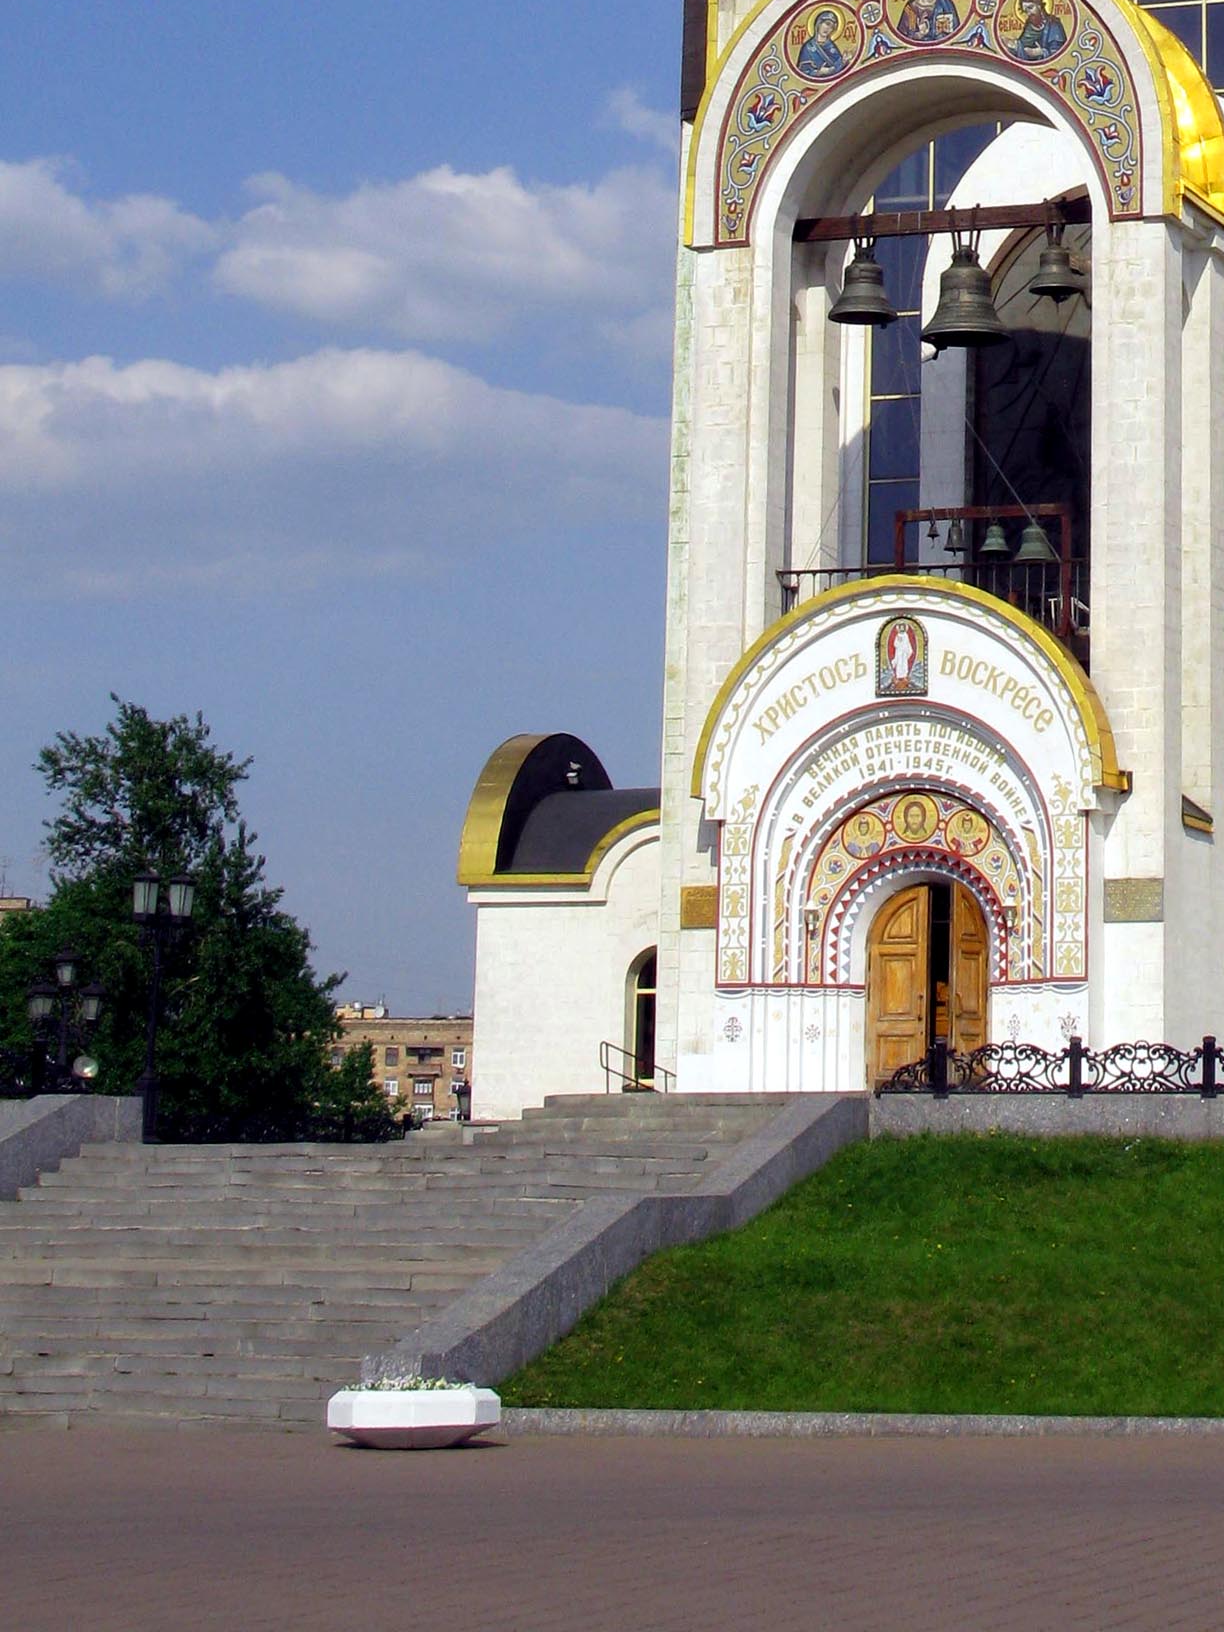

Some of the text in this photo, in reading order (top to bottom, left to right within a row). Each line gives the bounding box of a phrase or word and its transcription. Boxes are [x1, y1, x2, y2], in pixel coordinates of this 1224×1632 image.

[751, 652, 868, 747] ХРИСТОСЪ
[792, 739, 1028, 825] В ВЕЛИКОЙ ОТЕЧЕСТВЕННОЙ ВОЙНЕ
[806, 735, 859, 780] ВЕЧНАЯ
[864, 723, 921, 744] ПАМЯТЬ
